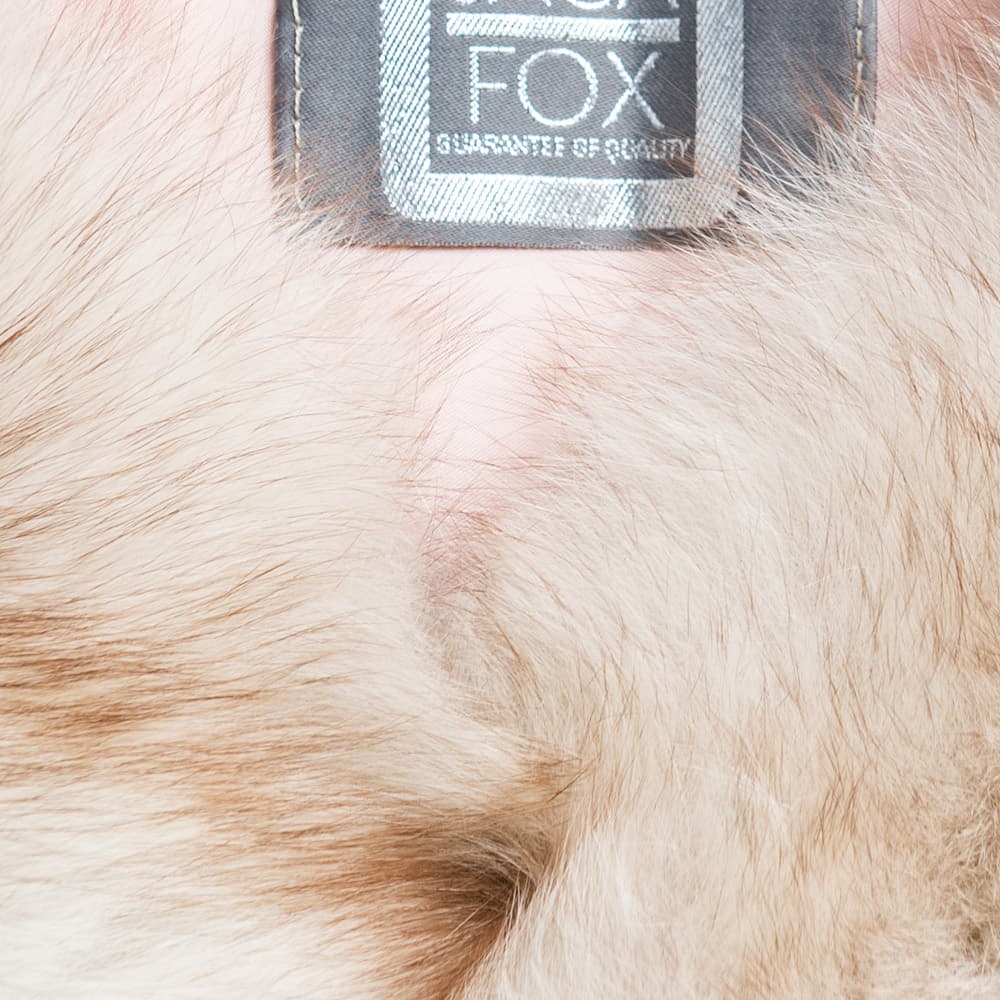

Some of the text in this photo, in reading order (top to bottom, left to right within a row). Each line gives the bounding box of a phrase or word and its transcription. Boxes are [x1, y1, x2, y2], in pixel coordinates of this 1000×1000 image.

[469, 46, 665, 128] FOX
[436, 132, 691, 165] GUARANTEE OF QUALITY
